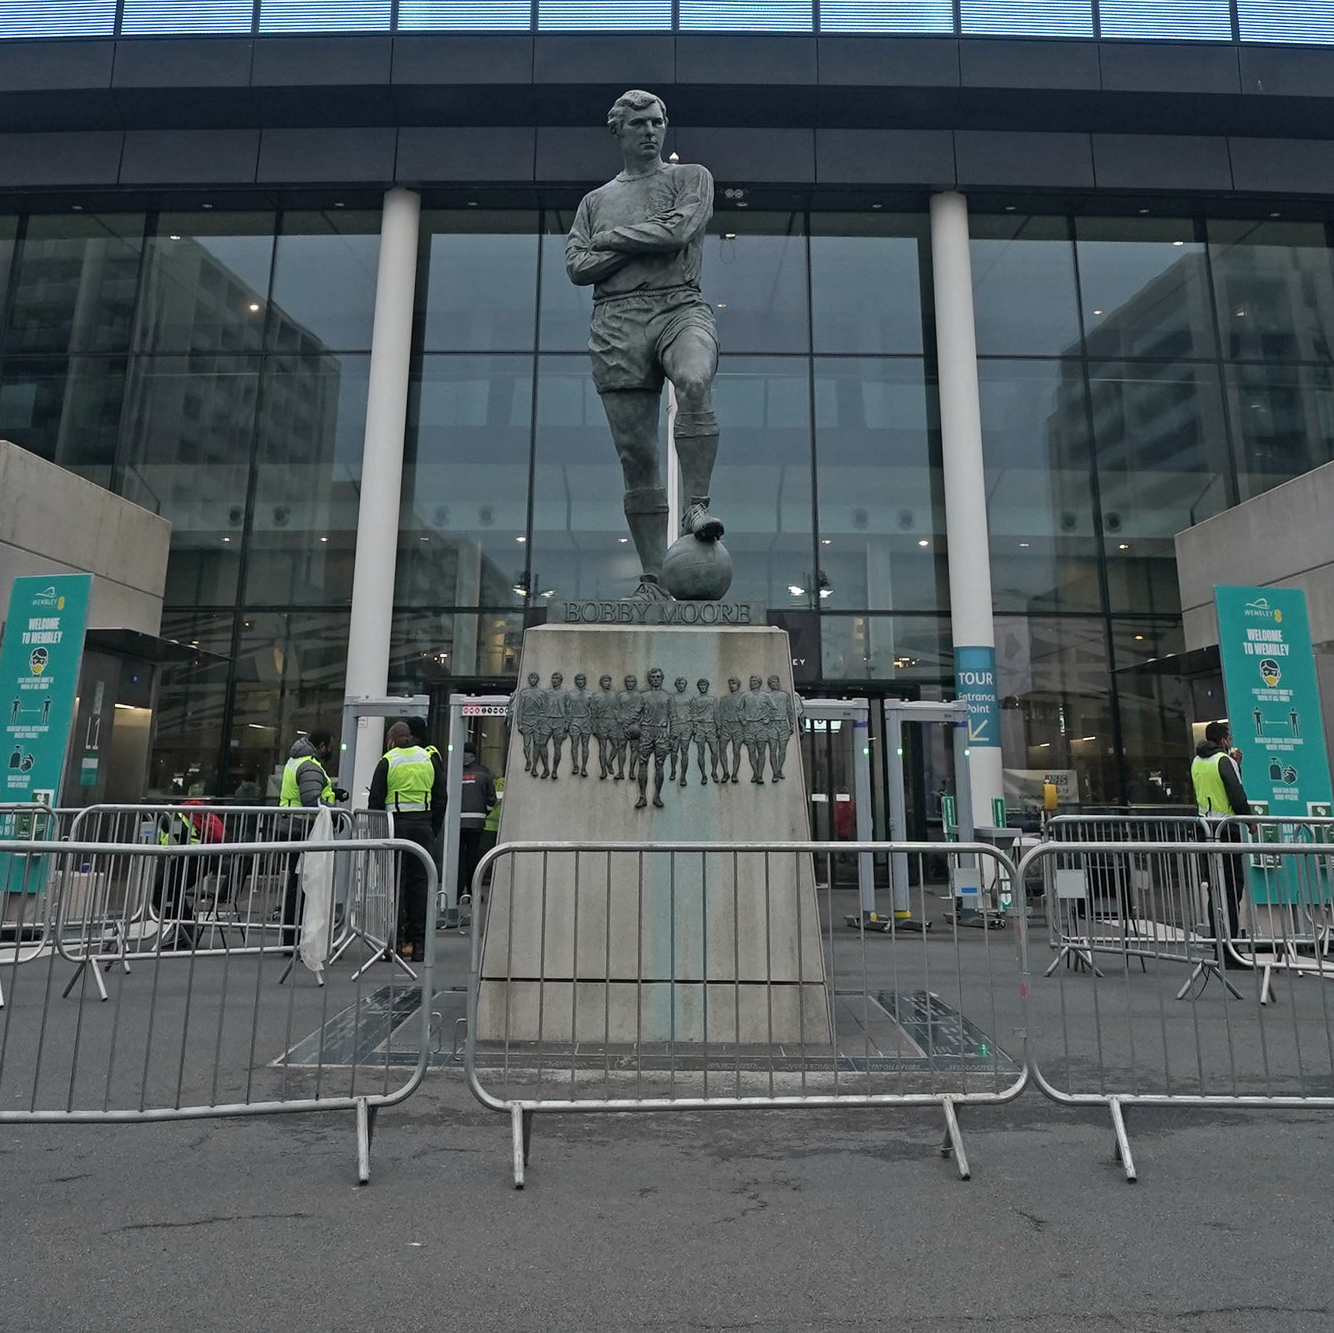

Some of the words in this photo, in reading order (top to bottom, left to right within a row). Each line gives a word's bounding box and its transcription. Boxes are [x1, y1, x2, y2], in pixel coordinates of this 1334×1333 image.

[563, 602, 651, 623] BOBBY
[658, 602, 750, 624] MOORE
[1244, 609, 1272, 617] WEMBLEY
[28, 617, 60, 630] WELCOME
[22, 632, 29, 644] TO
[30, 631, 63, 643] WEMBLEY
[1246, 628, 1282, 641] WELCOME
[1243, 642, 1253, 654] TO
[1253, 643, 1288, 655] WEMBLEY
[958, 672, 992, 684] TOUR
[958, 692, 995, 701] Entrance
